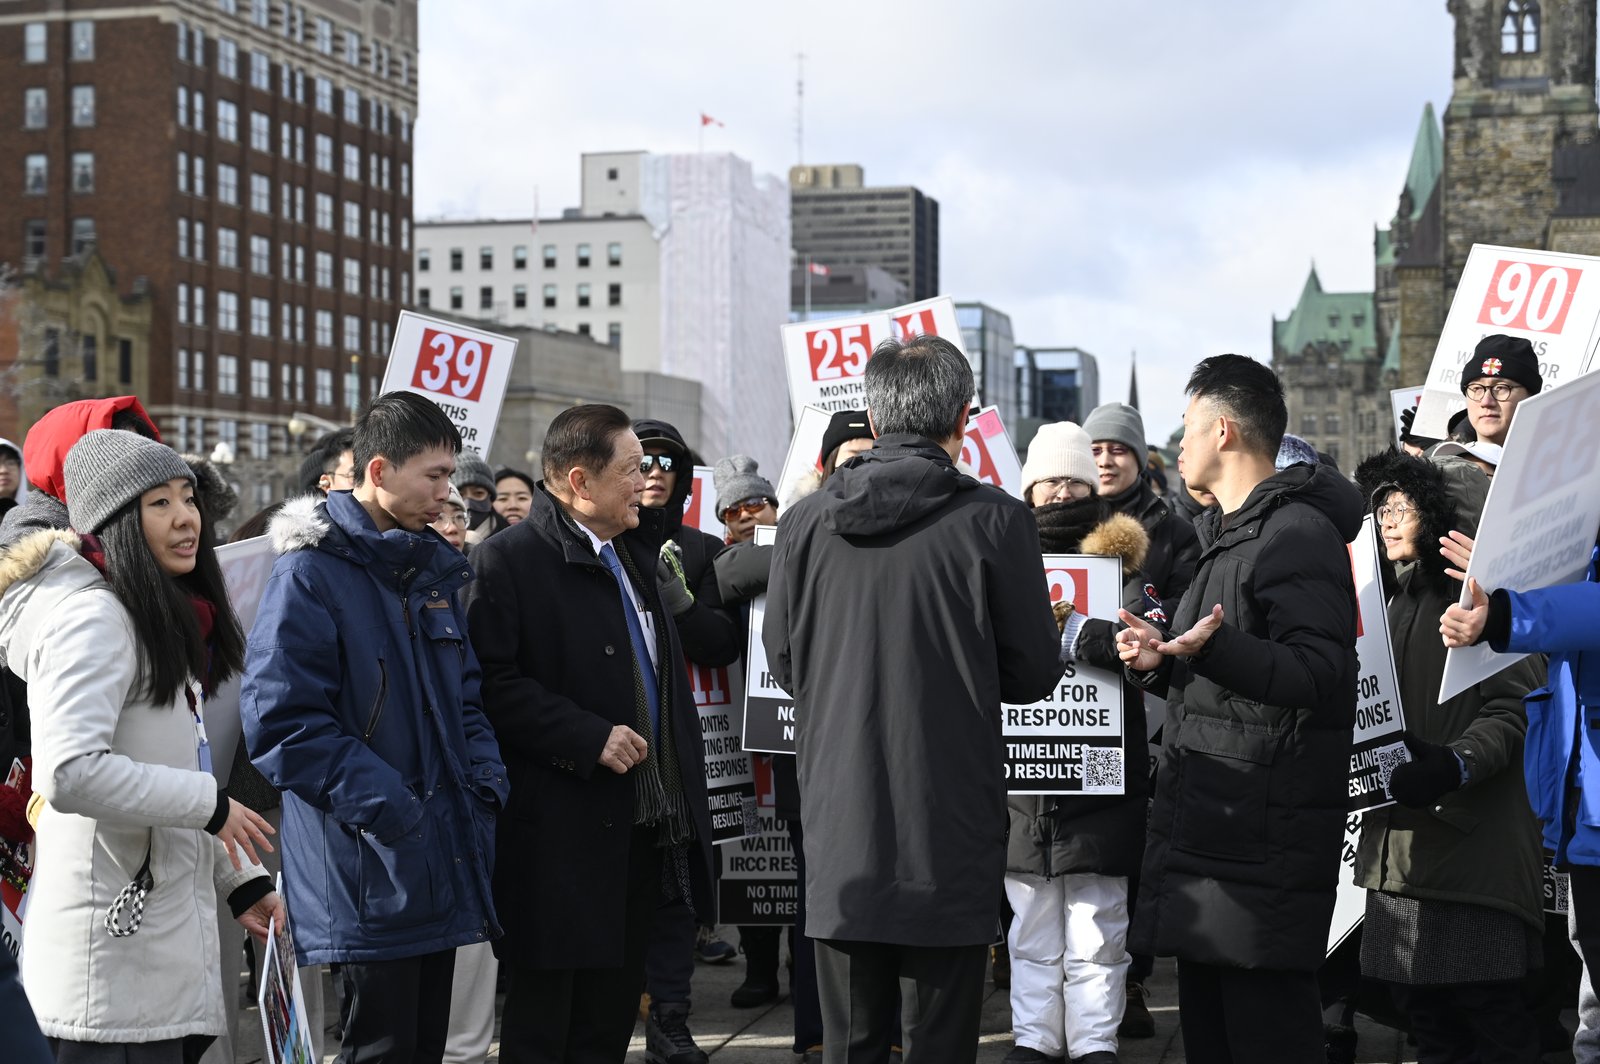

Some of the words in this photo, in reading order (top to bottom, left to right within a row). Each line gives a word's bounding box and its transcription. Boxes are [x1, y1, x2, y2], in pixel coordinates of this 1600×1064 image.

[1490, 262, 1569, 331] 90
[813, 325, 868, 380] 25
[421, 333, 483, 398] 39
[820, 382, 865, 397] MONTH
[1060, 684, 1098, 702] FOR
[701, 714, 729, 734] ONTHS
[1007, 708, 1110, 727] RESPONSE
[723, 735, 742, 753] FOR
[1015, 763, 1083, 779] RESULTS
[1348, 770, 1385, 798] ESULTS
[713, 810, 743, 830] RESULTS
[730, 856, 766, 872] IRCC
[746, 885, 766, 899] NO
[752, 901, 772, 915] NO
